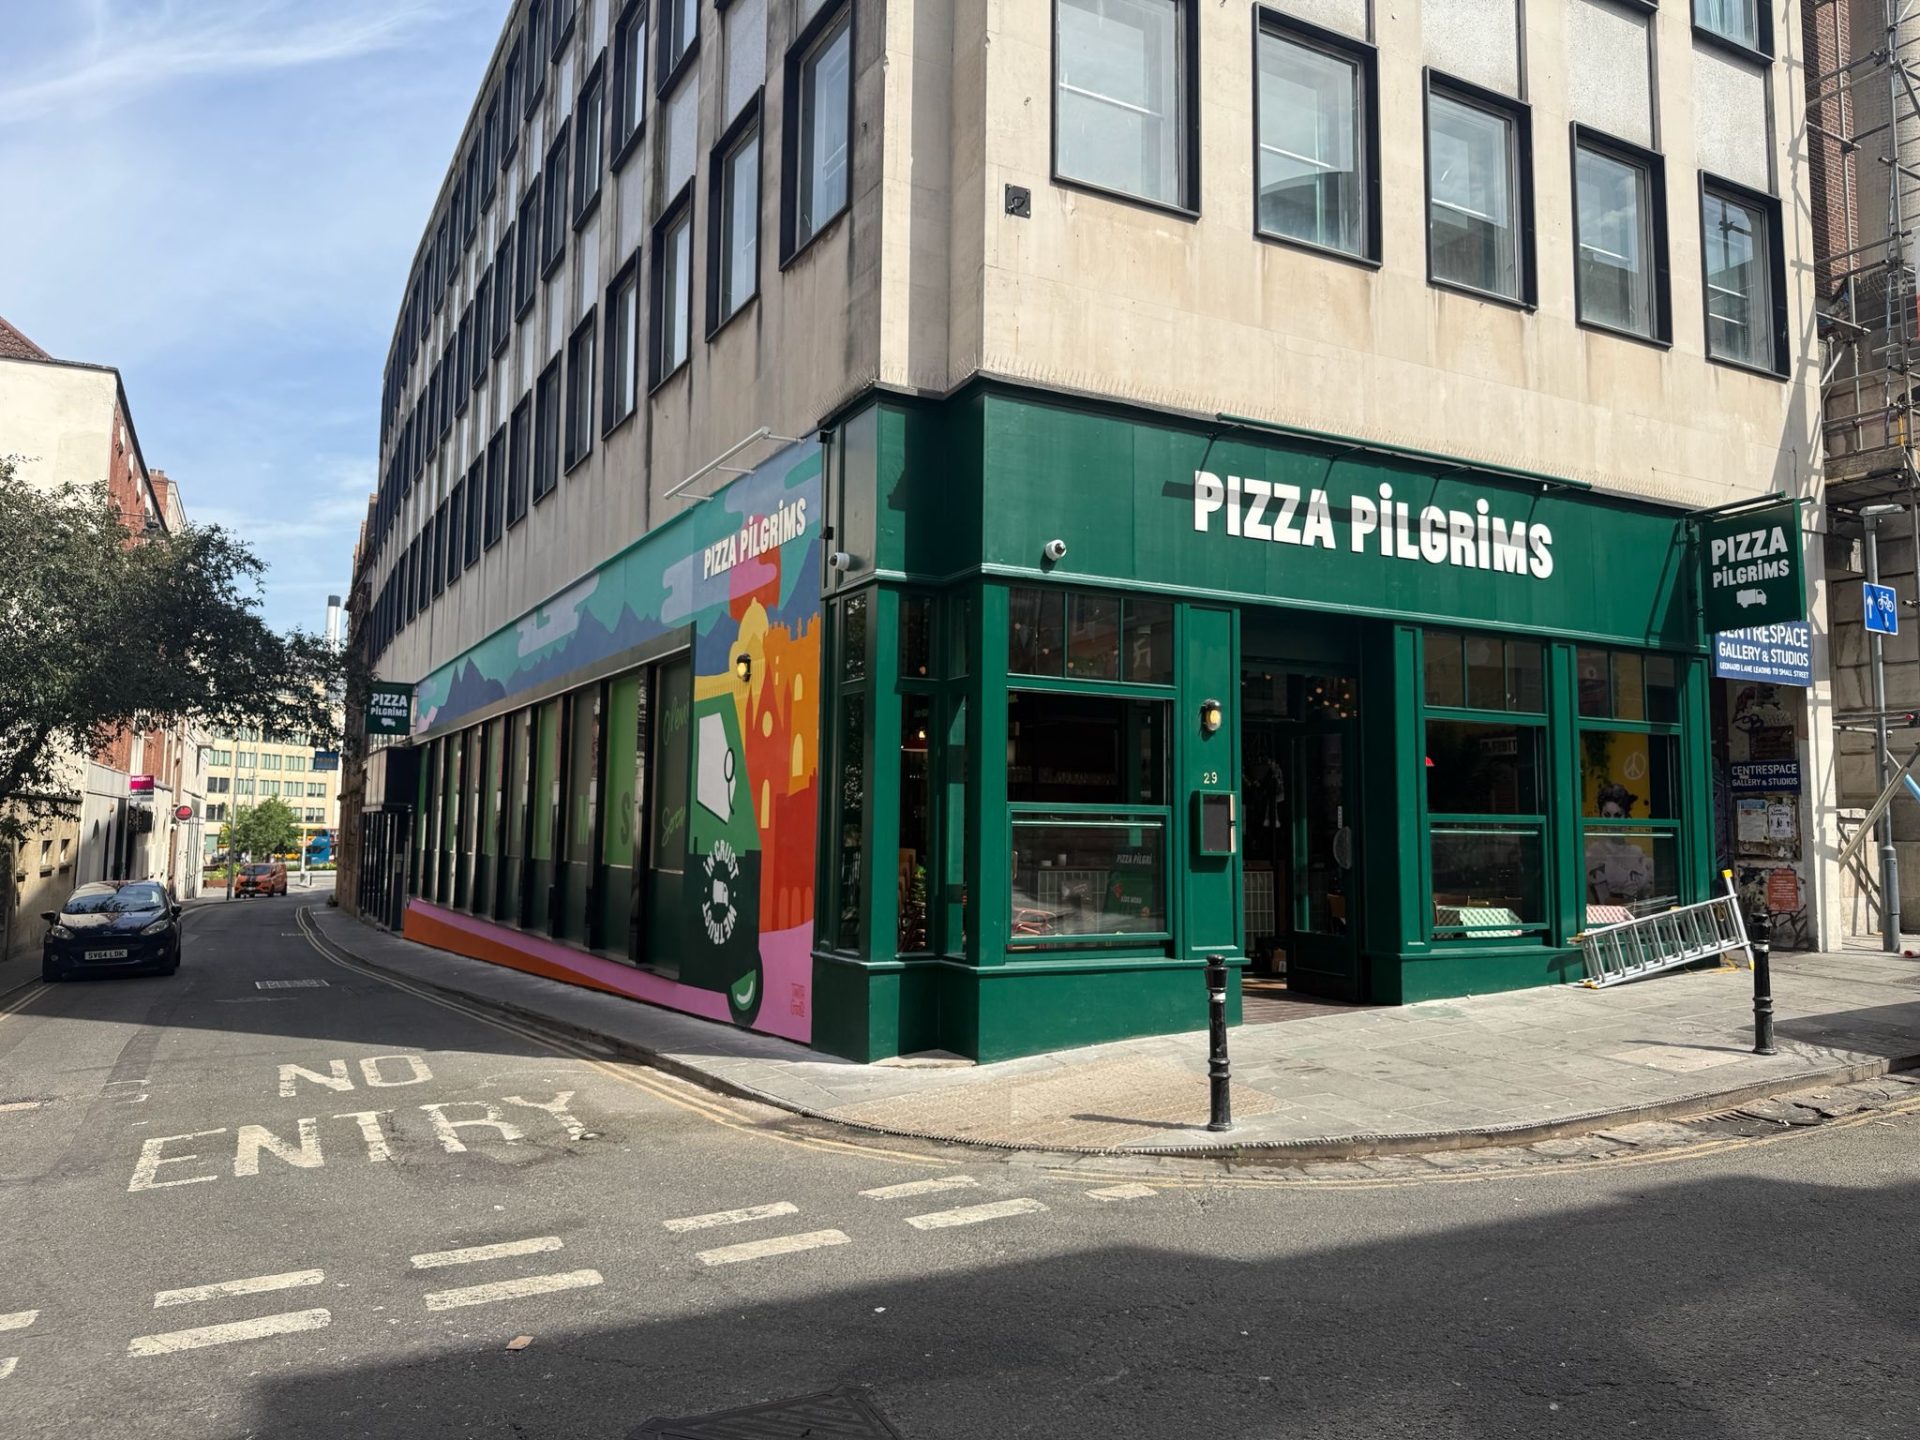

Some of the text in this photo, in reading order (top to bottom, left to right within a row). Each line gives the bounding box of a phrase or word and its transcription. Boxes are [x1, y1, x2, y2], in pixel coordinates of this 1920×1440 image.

[704, 497, 807, 581] PIZZA PiLGRiMS
[1194, 470, 1554, 579] PIZZA PiLGRiMS
[1711, 526, 1789, 566] PIZZA
[1713, 559, 1790, 588] PiLGRiMS
[1719, 641, 1809, 667] GALLERY & STUDIOS
[1741, 665, 1753, 673] LANE
[1753, 665, 1771, 675] LEADING
[1772, 667, 1779, 675] TO
[1779, 668, 1793, 677] SMALL
[1793, 670, 1809, 679] STREET
[371, 693, 408, 707] PIZZA
[1203, 771, 1218, 784] 29
[1731, 763, 1797, 776] CENTRESPACE
[1732, 778, 1761, 787] GALLERY
[1768, 777, 1798, 786] STUDIOS
[714, 840, 740, 880] CRUST
[702, 901, 726, 945] TRUST
[277, 1055, 434, 1098] NO
[127, 1091, 591, 1193] ENTRY
